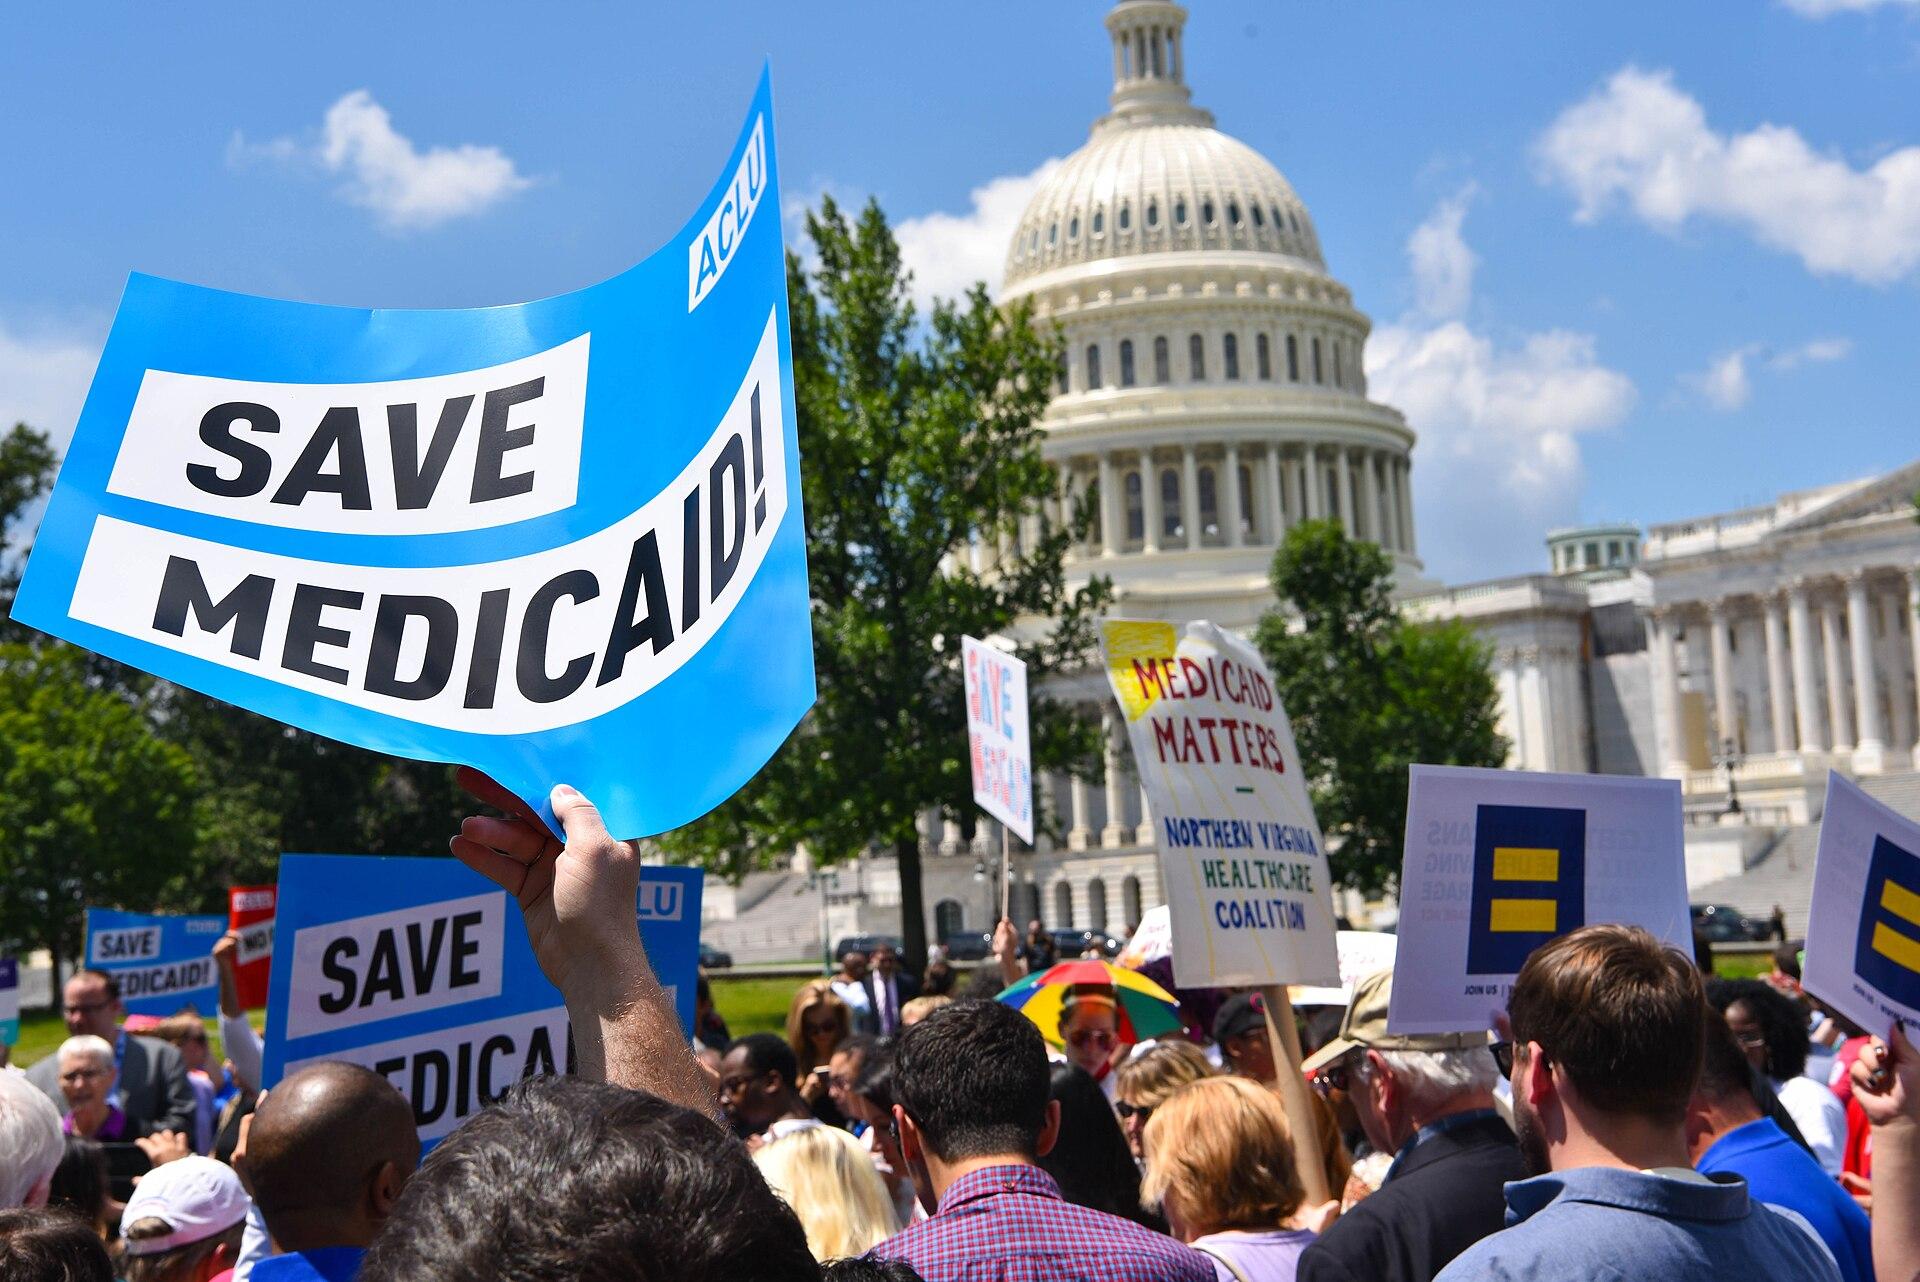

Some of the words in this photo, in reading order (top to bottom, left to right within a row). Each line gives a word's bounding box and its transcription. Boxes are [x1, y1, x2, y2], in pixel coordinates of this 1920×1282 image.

[694, 130, 761, 299] ACLU
[186, 376, 546, 511] SAVE
[151, 381, 768, 710] MEDICAID!
[1132, 656, 1274, 712] MEDICAID
[1151, 716, 1285, 774] MATTERS
[1164, 816, 1254, 849] NORTHERN
[1256, 821, 1318, 857] VIRGINIA
[1201, 859, 1314, 893] HEALTHCARE
[1215, 900, 1306, 930] COALITION
[100, 932, 155, 958] SAVE
[318, 910, 483, 1015] SAVE
[117, 960, 210, 998] EDICAID!
[1464, 984, 1484, 995] JOIN
[1485, 984, 1498, 995] US
